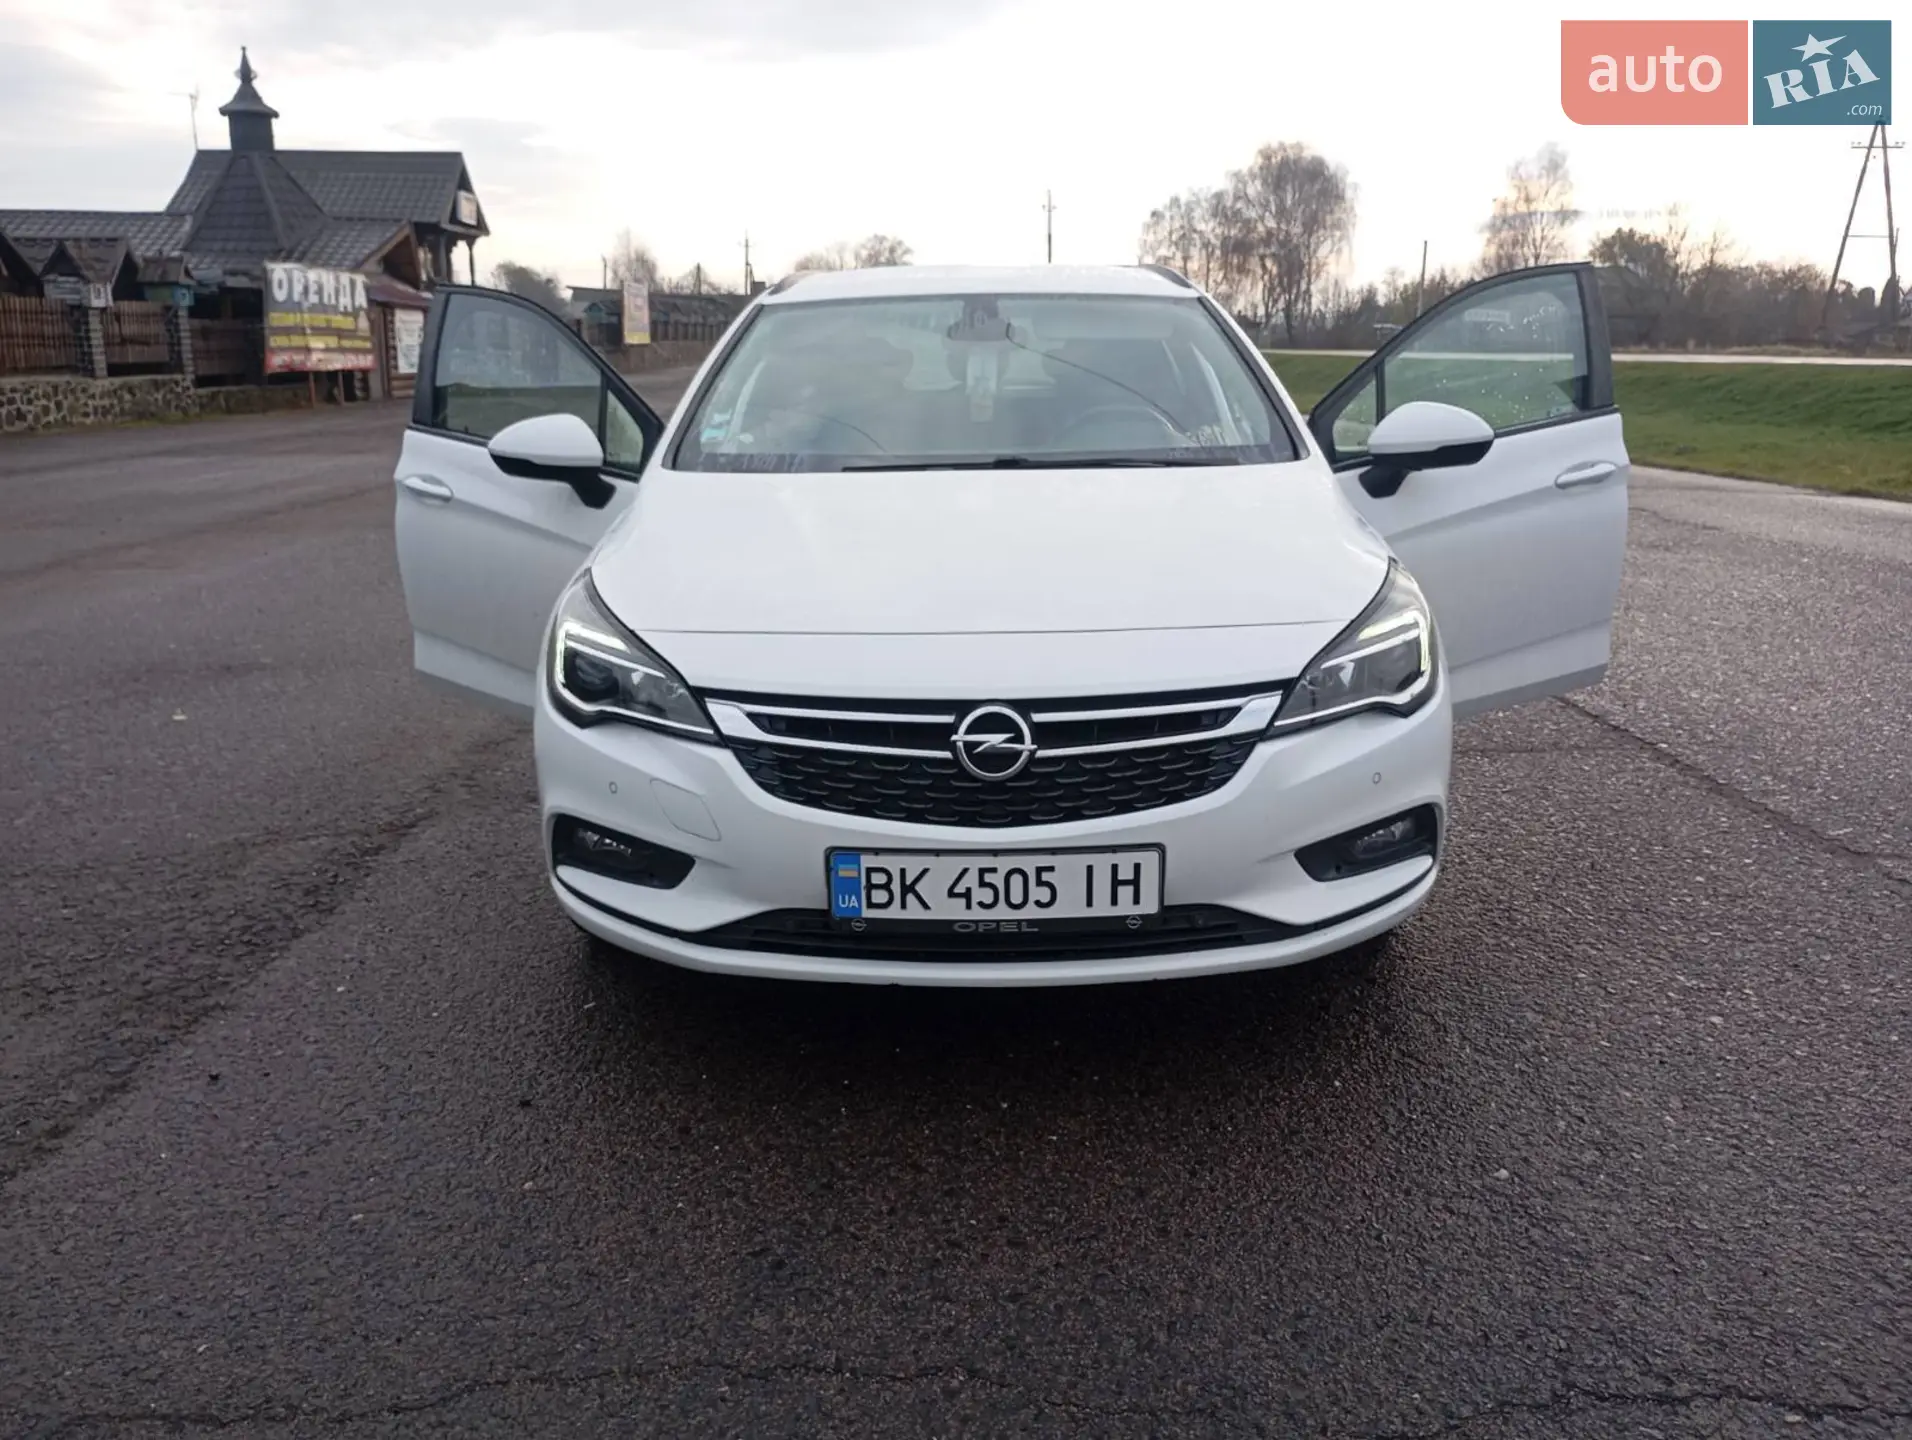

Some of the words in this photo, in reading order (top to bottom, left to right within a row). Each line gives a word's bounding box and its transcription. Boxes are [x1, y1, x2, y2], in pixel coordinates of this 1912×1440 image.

[271, 267, 369, 312] ОРЕНДА
[838, 894, 859, 908] UA
[864, 866, 931, 911] BK
[946, 865, 1058, 910] 4505
[1085, 862, 1142, 907] IH
[953, 921, 1039, 933] OPEL
